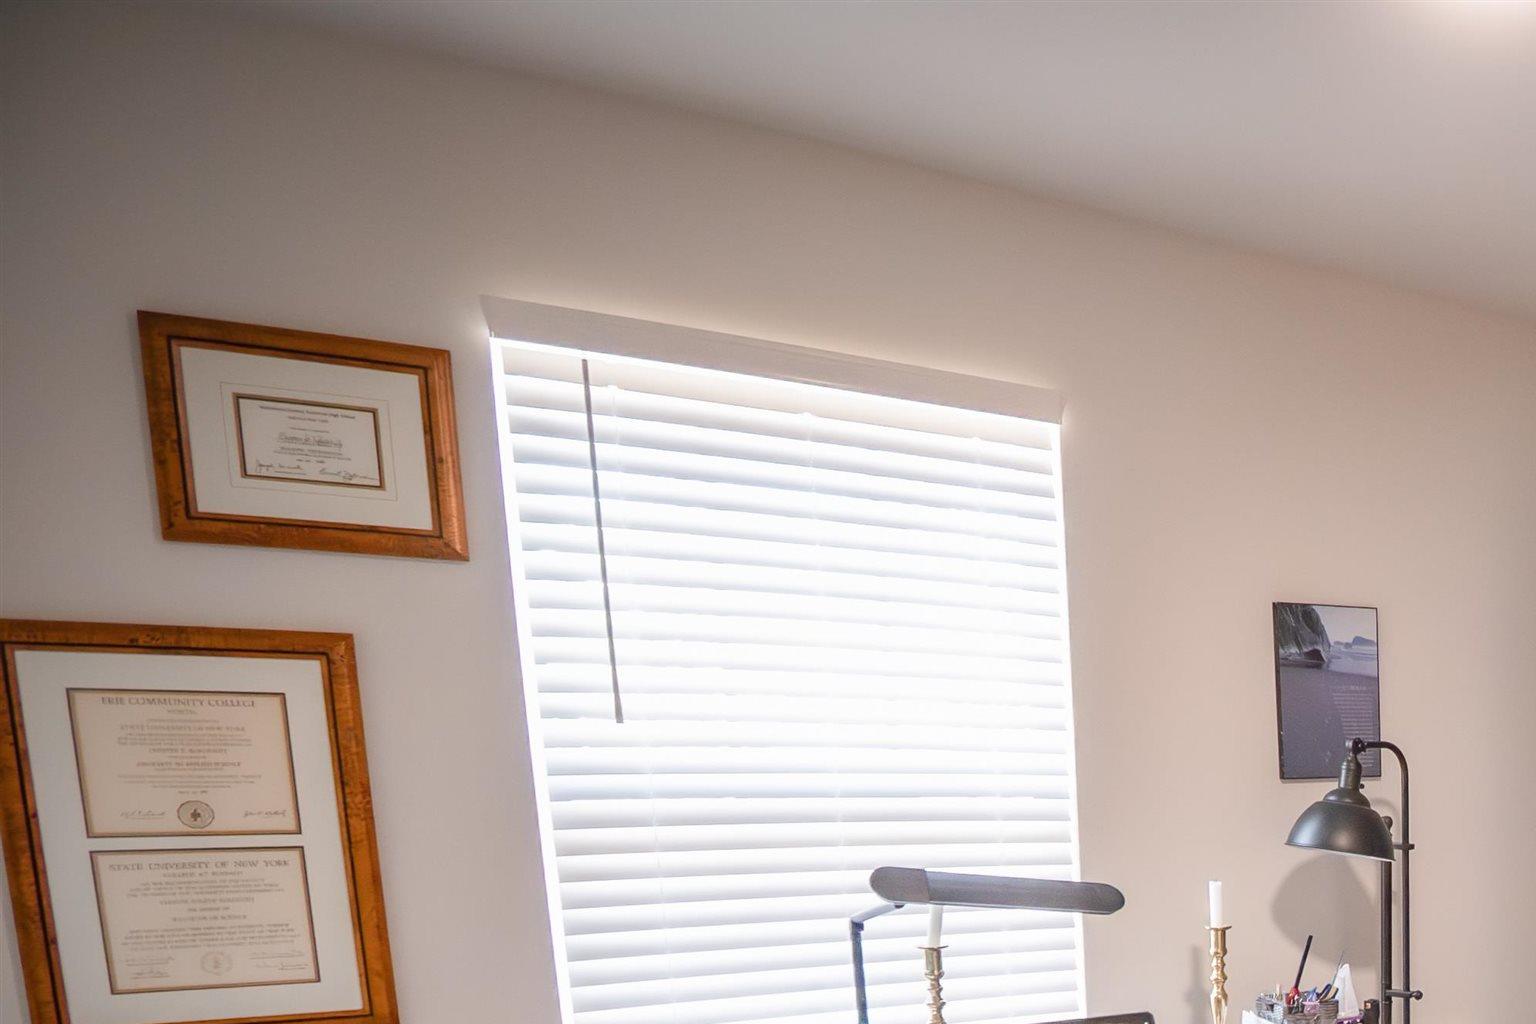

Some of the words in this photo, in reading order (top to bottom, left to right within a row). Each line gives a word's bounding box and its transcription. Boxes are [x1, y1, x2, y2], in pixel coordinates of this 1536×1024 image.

[127, 696, 205, 707] COMMUNITY
[108, 861, 143, 872] STATE
[149, 861, 210, 871] UNIVERSITY
[215, 860, 229, 869] OF
[233, 859, 259, 868] NEW
[263, 859, 291, 868] YORK
